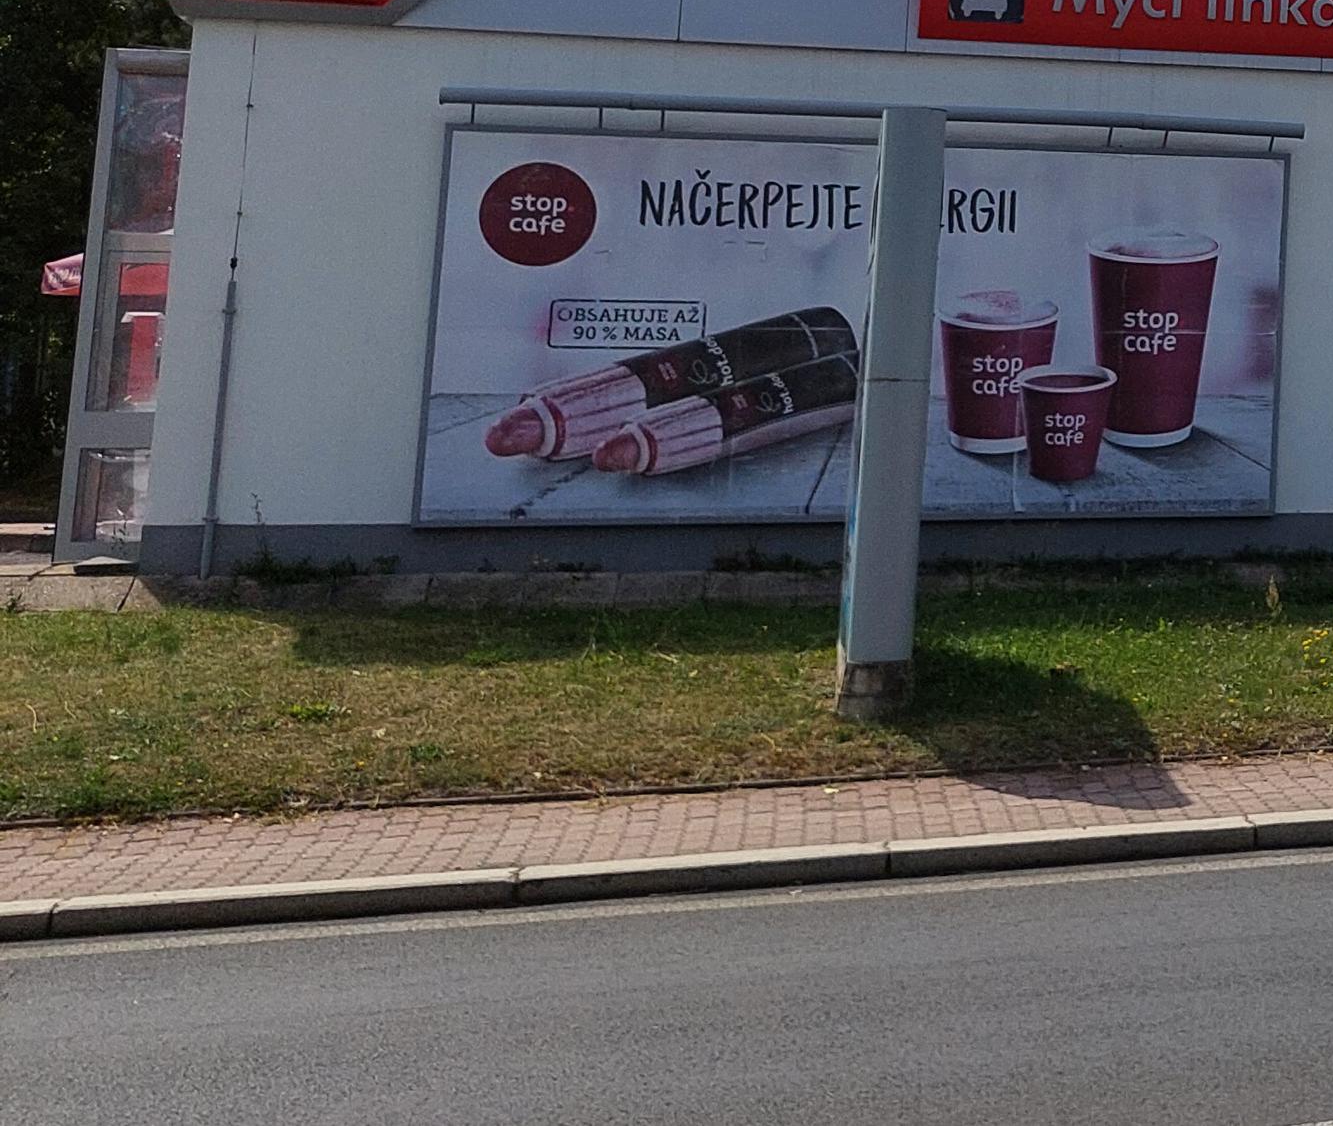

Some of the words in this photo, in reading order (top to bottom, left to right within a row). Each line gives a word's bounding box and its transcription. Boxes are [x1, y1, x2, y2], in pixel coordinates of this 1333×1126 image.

[510, 194, 568, 217] stop
[639, 170, 864, 230] NAČERPEJTE
[940, 188, 1017, 234] RGII
[510, 215, 566, 236] cafe
[558, 307, 669, 323] OBSAHUJE
[674, 305, 700, 323] AŽ
[1123, 308, 1179, 334] stop
[573, 326, 596, 340] 90
[602, 326, 618, 341] %
[623, 327, 681, 341] MASA
[1123, 332, 1177, 355] cafe
[972, 355, 1024, 377] stop
[972, 376, 1021, 398] cafe
[1044, 412, 1087, 431] stop
[1044, 430, 1085, 447] cafe
